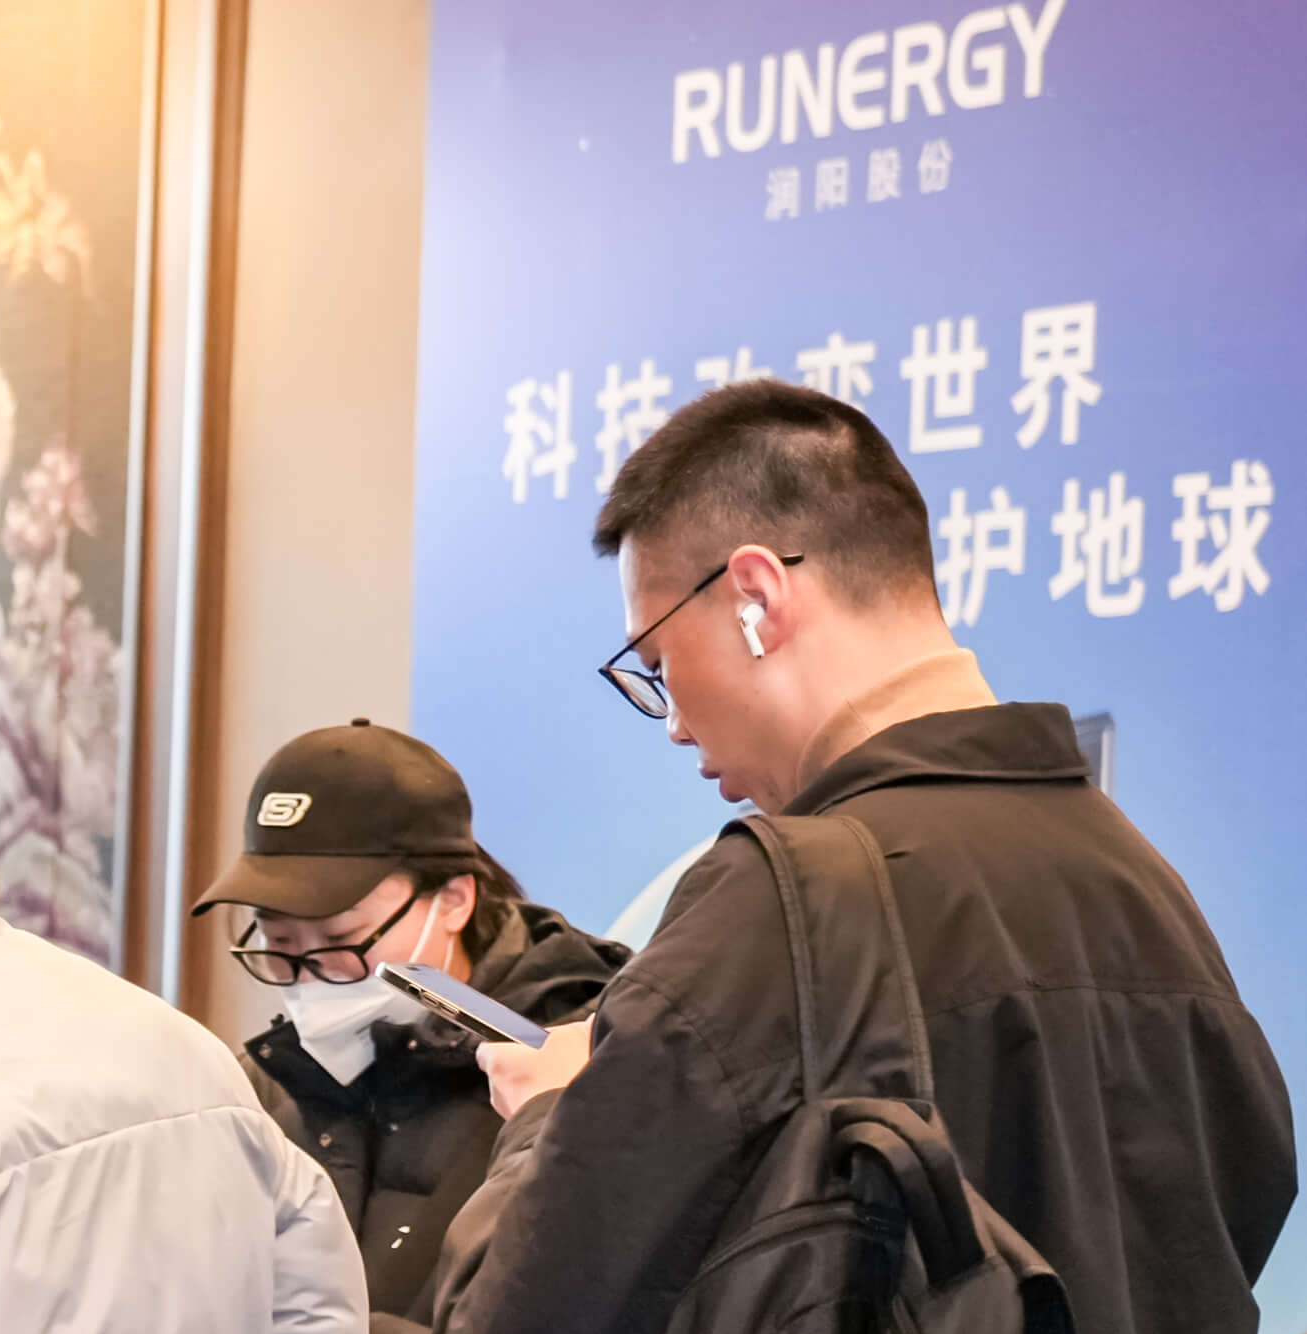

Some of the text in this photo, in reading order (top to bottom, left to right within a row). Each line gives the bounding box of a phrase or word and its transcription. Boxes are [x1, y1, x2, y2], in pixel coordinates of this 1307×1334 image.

[672, 0, 1066, 163] RUNERGY
[764, 138, 953, 221] 润阳股份
[935, 459, 1275, 628] 护地球
